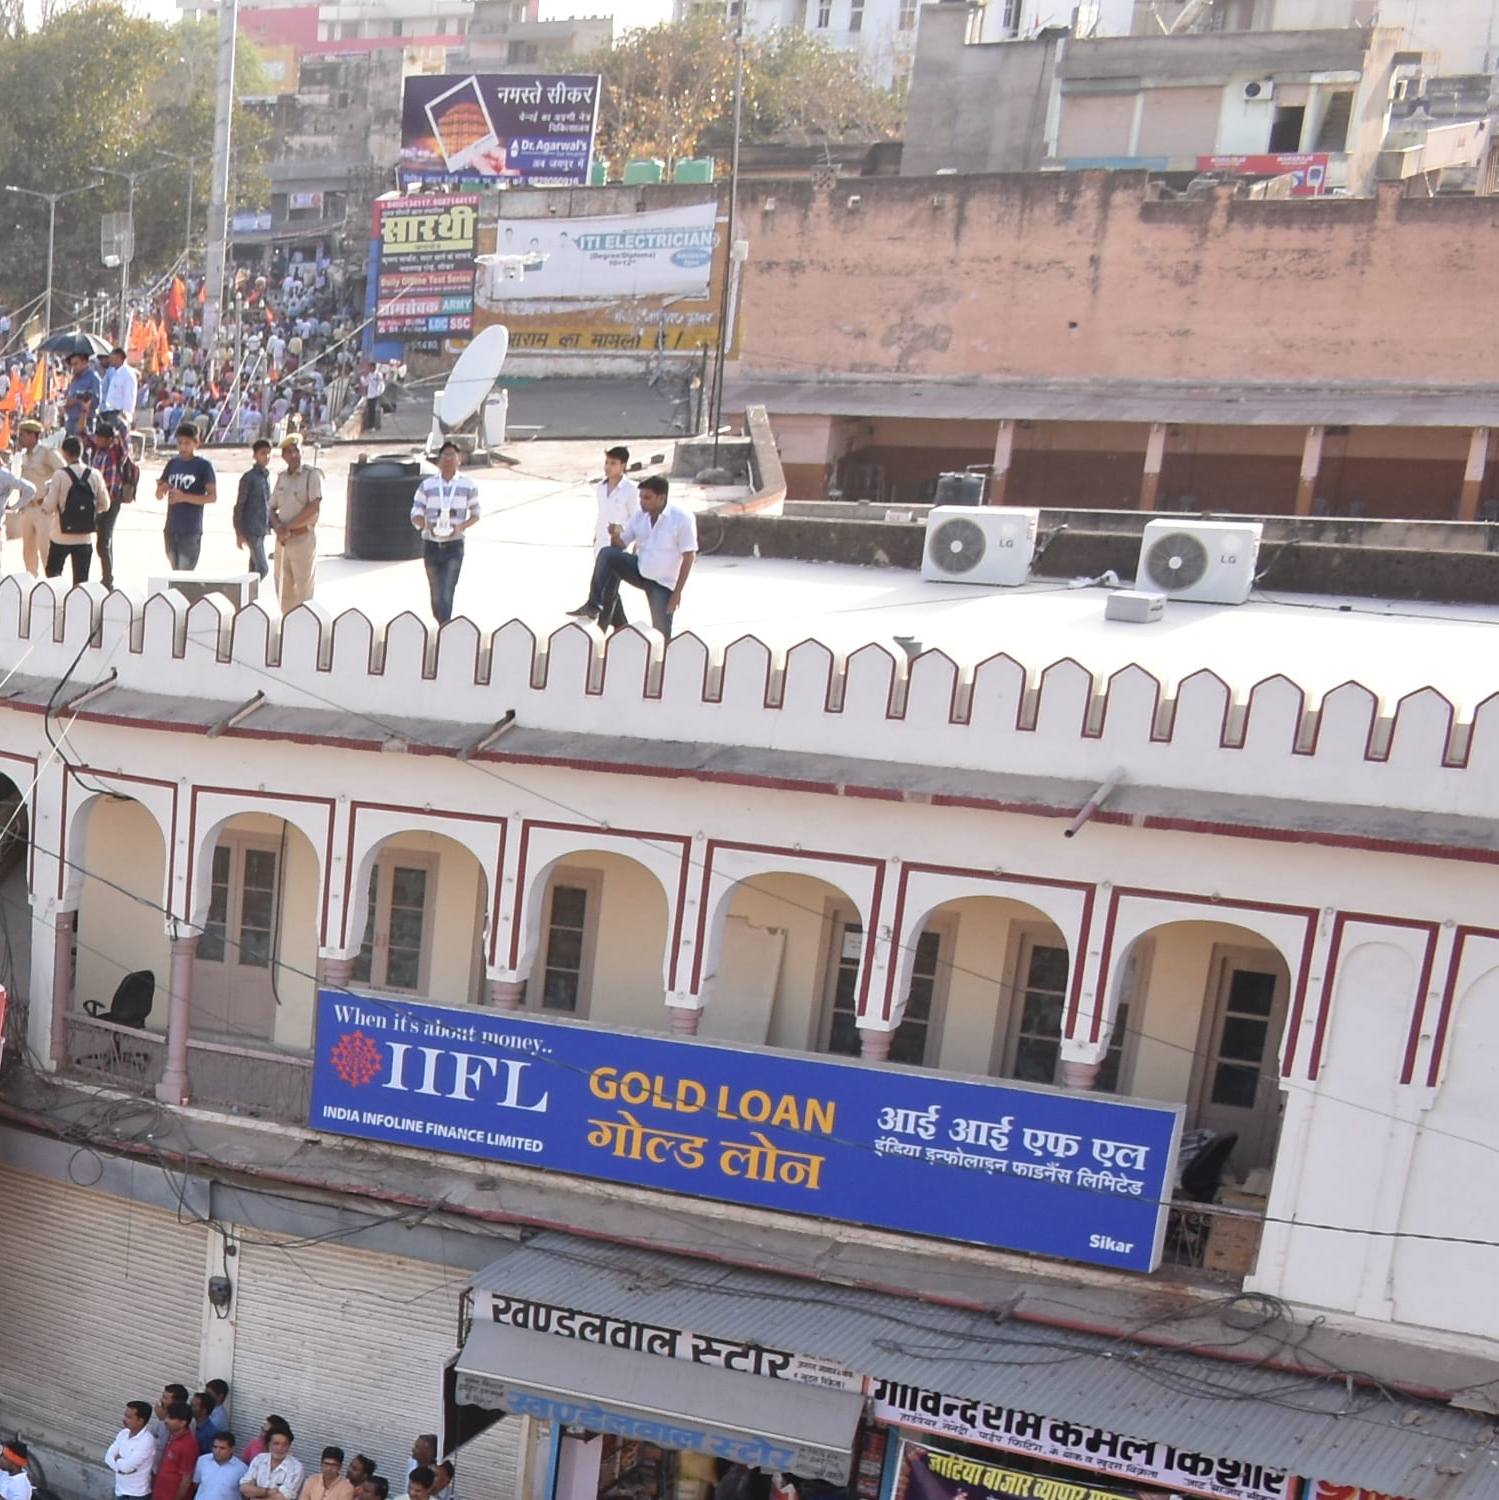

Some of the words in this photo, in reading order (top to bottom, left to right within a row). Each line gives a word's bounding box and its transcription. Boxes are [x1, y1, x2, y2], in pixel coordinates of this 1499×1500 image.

[497, 82, 542, 105] नमस्ते
[547, 81, 594, 104] सीकर
[521, 140, 535, 151] Dr.
[536, 139, 587, 153] Agarwal's
[380, 206, 477, 243] सारथी
[580, 235, 600, 249] ITI
[605, 231, 712, 248] ELECTRICIAN
[430, 275, 446, 284] Test
[443, 298, 471, 310] ARMY
[428, 319, 448, 331] LDC
[449, 318, 471, 330] SSC
[334, 1005, 387, 1029] When
[393, 1012, 419, 1034] it's
[423, 1019, 477, 1042] about
[381, 1041, 549, 1113] IIFL
[589, 1067, 707, 1113] GOLD
[717, 1085, 836, 1135] LOAN
[323, 1105, 360, 1123] INDIA
[362, 1111, 424, 1133] INFOLINE
[425, 1122, 484, 1143] FINANCE
[487, 1132, 543, 1153] LIMITED
[877, 1105, 941, 1141] आई
[948, 1116, 1015, 1152] आई
[1023, 1127, 1082, 1157] एफ
[1091, 1138, 1150, 1171] एल
[587, 1110, 709, 1169] गोल्ड
[719, 1131, 826, 1189] लोन
[1076, 1167, 1144, 1195] लिमिटेड
[1089, 1233, 1134, 1254] Sikar
[491, 1294, 683, 1360] खण्डलवाल
[691, 1332, 796, 1380] स्टर
[707, 1430, 796, 1472] स्टोर
[1049, 1417, 1156, 1470] कमल
[1165, 1445, 1288, 1497] किशर
[982, 1463, 1032, 1498] बाजार
